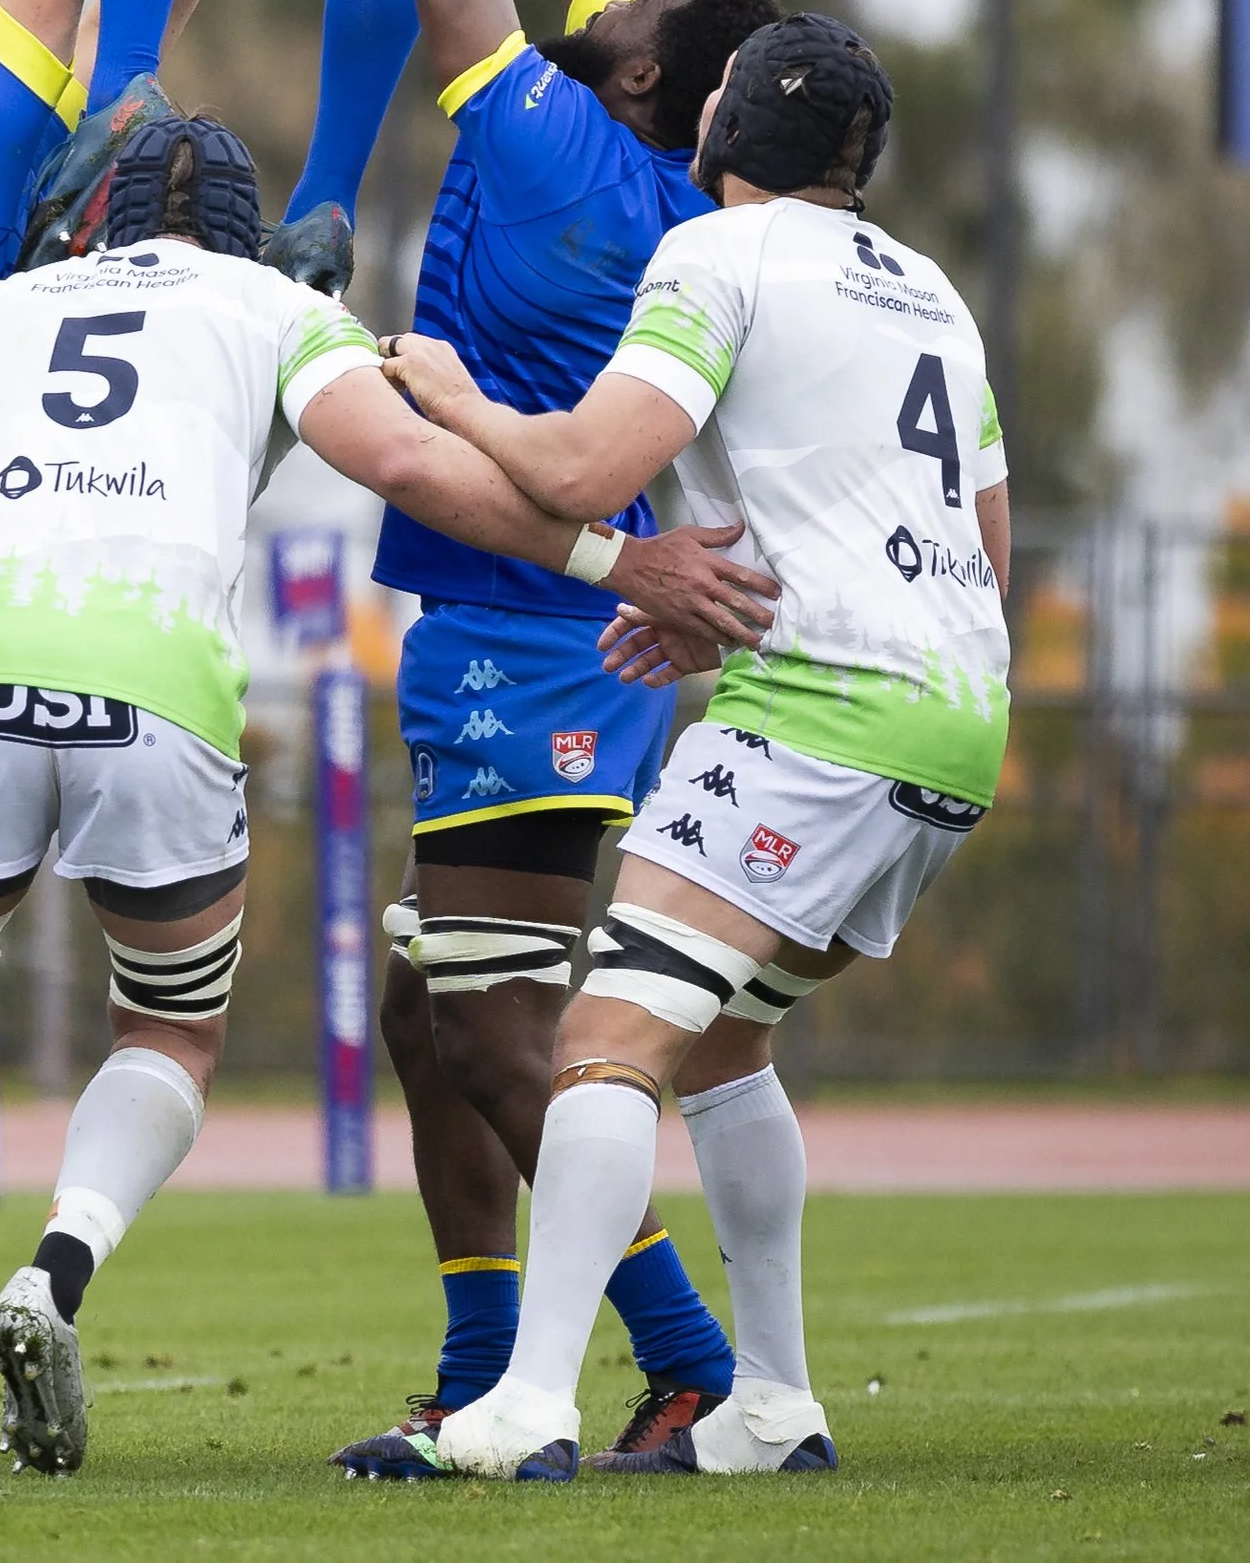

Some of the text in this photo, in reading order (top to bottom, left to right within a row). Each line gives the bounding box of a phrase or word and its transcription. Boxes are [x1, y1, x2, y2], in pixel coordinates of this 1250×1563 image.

[56, 265, 190, 282] Virgia Mason
[136, 273, 198, 289] Health
[839, 264, 939, 303] Virginia Mason
[835, 281, 955, 325] Franciscan Health
[41, 310, 147, 429] 5
[896, 352, 962, 508] 4
[44, 461, 166, 500] Tukwila
[556, 735, 593, 749] MLR
[754, 830, 792, 859] MLR
